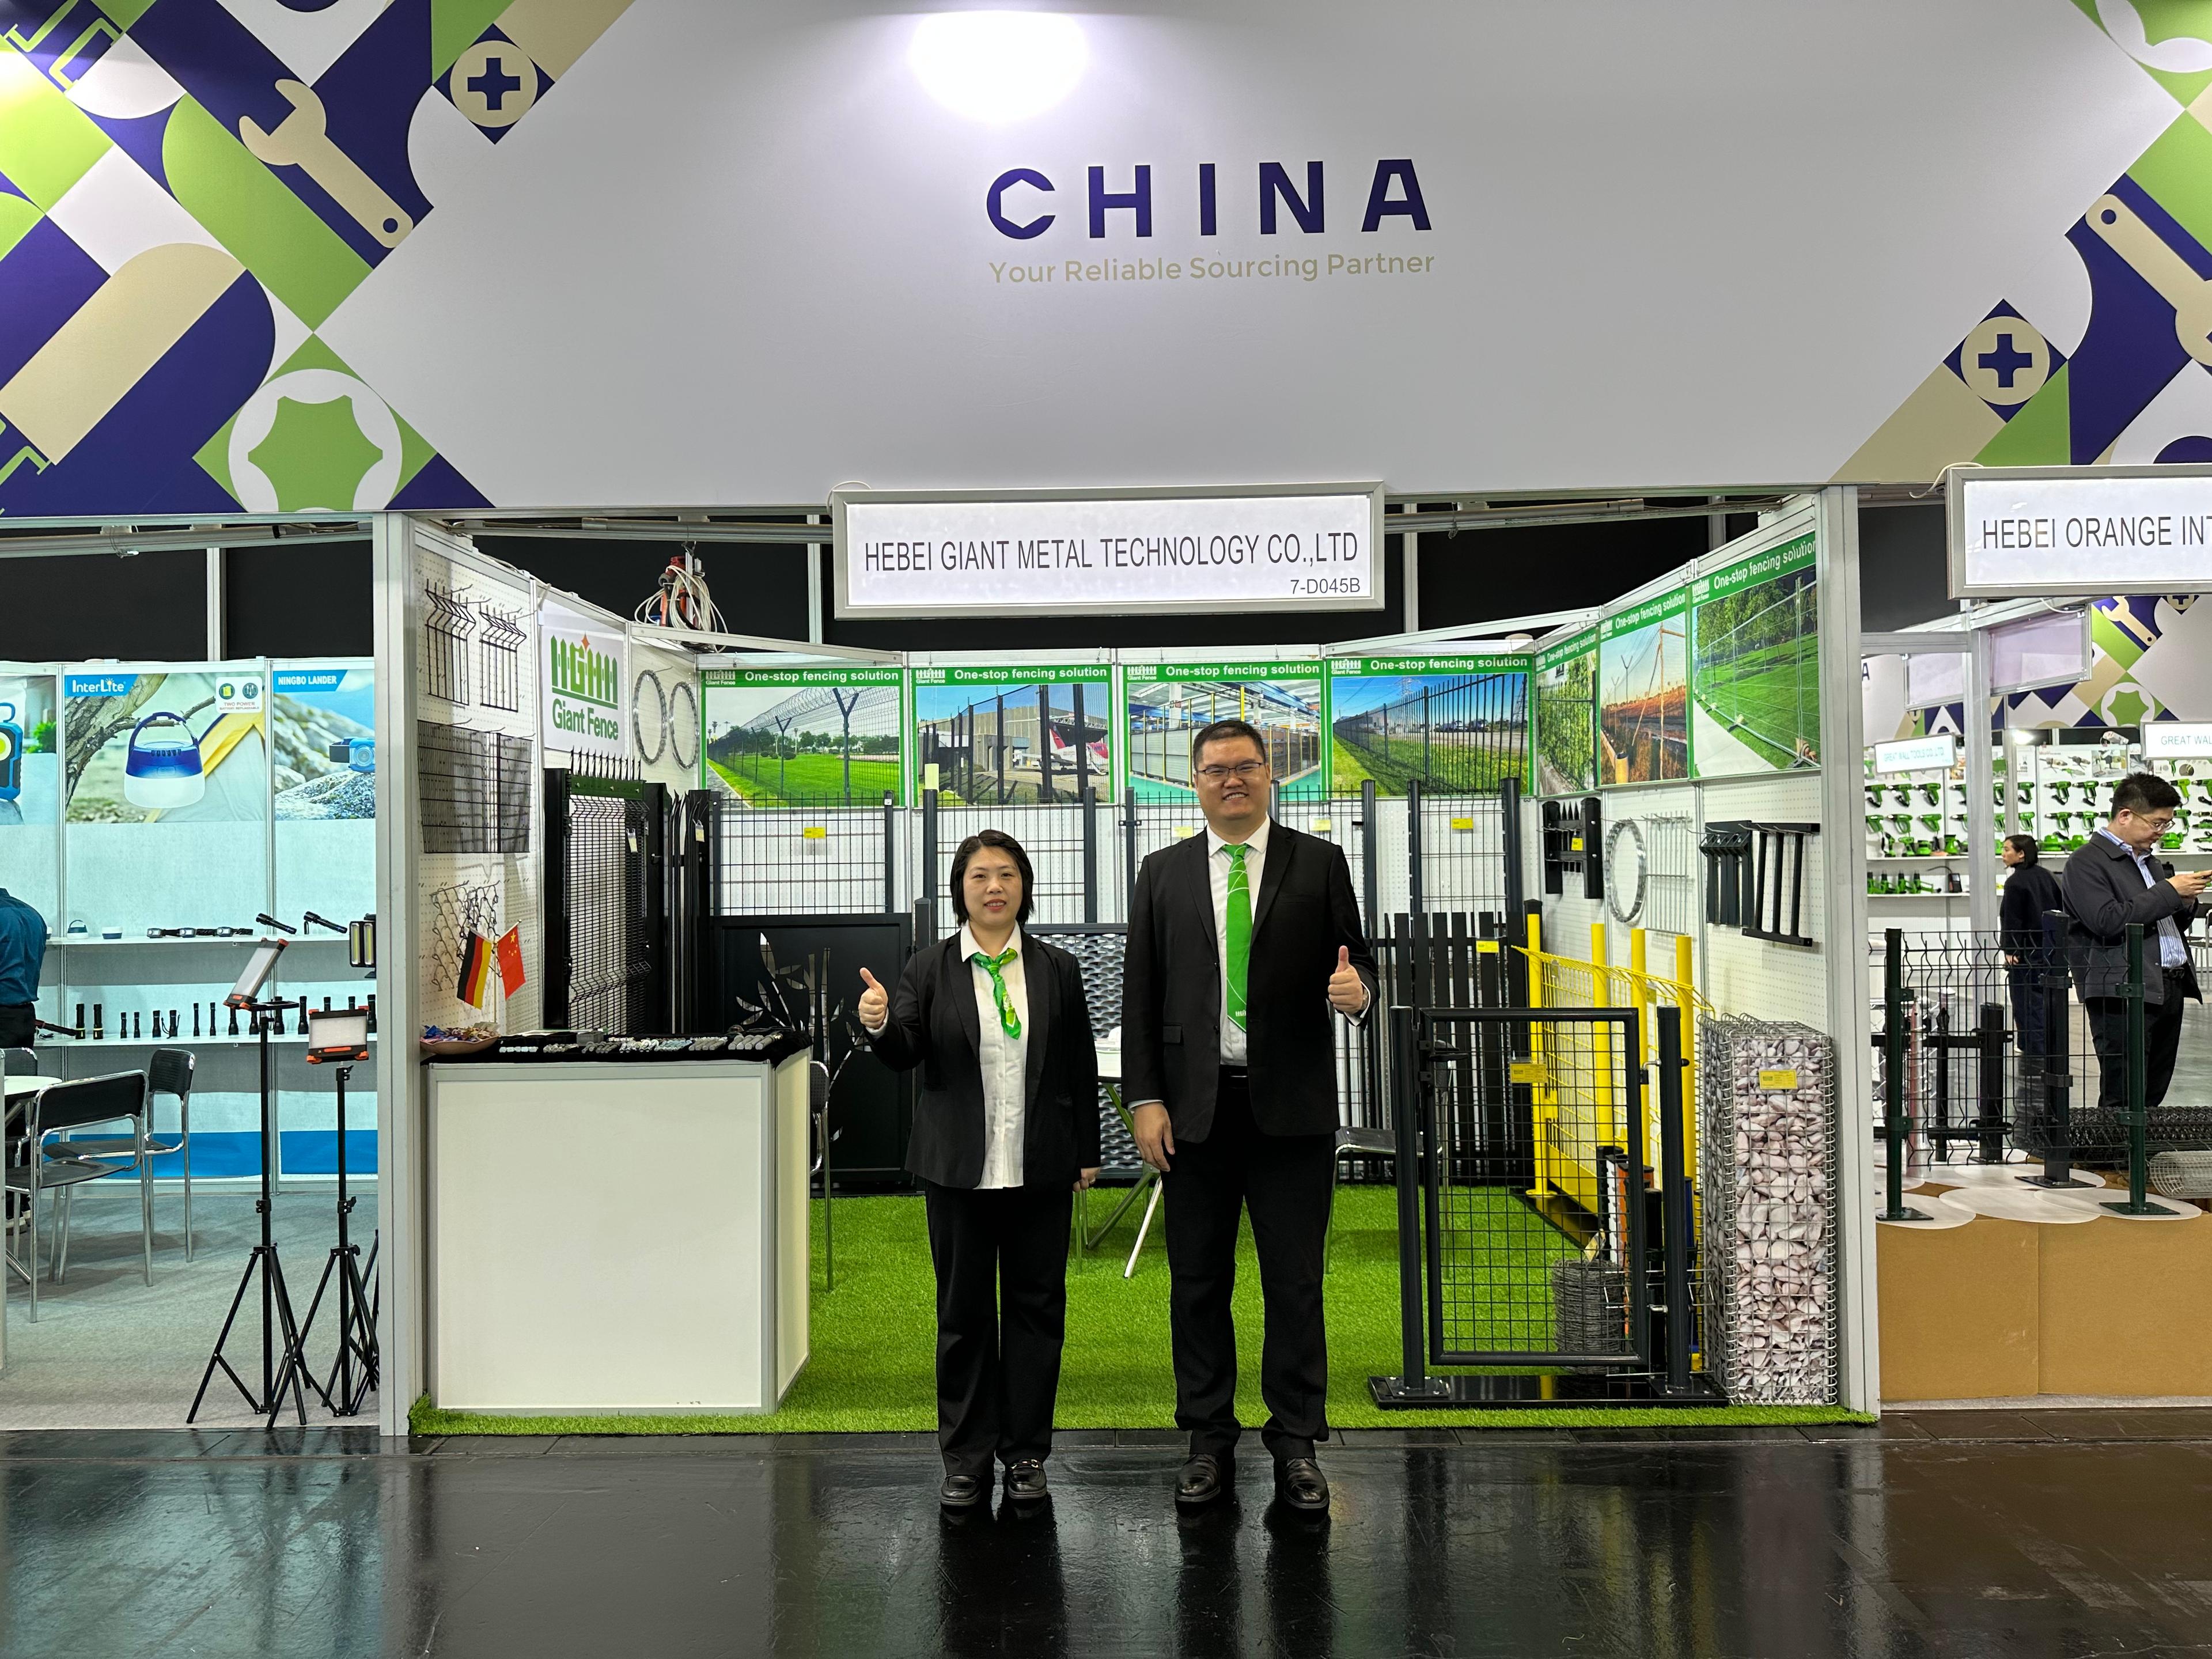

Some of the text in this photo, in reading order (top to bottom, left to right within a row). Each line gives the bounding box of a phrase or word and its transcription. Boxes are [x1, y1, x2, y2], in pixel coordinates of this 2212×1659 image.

[986, 159, 1433, 240] CHINA
[988, 252, 1435, 283] Your Reliable Sourcing Partner
[1983, 518, 2055, 549] HEBEI
[2066, 516, 2172, 547] ORANGE
[865, 532, 1358, 571] HEBEI GIANT METAL TECHNOLOGY CO.,LTD
[1714, 568, 1748, 589] One-stop
[1749, 555, 1781, 577] fencing
[1290, 577, 1361, 594] 7-D045B
[1615, 593, 1685, 629] One-stop fencing solution
[1166, 662, 1320, 677] One-stop fencing solution
[1370, 657, 1528, 671] One-stop fencing solution
[278, 675, 337, 685] NINGBO LANDER
[744, 670, 899, 682] One-stop fencing solution
[954, 667, 1107, 681] One-stop fencing solution
[72, 677, 125, 693] InterLite
[552, 698, 618, 740] Giant Fence
[2161, 735, 2191, 745] GREAT
